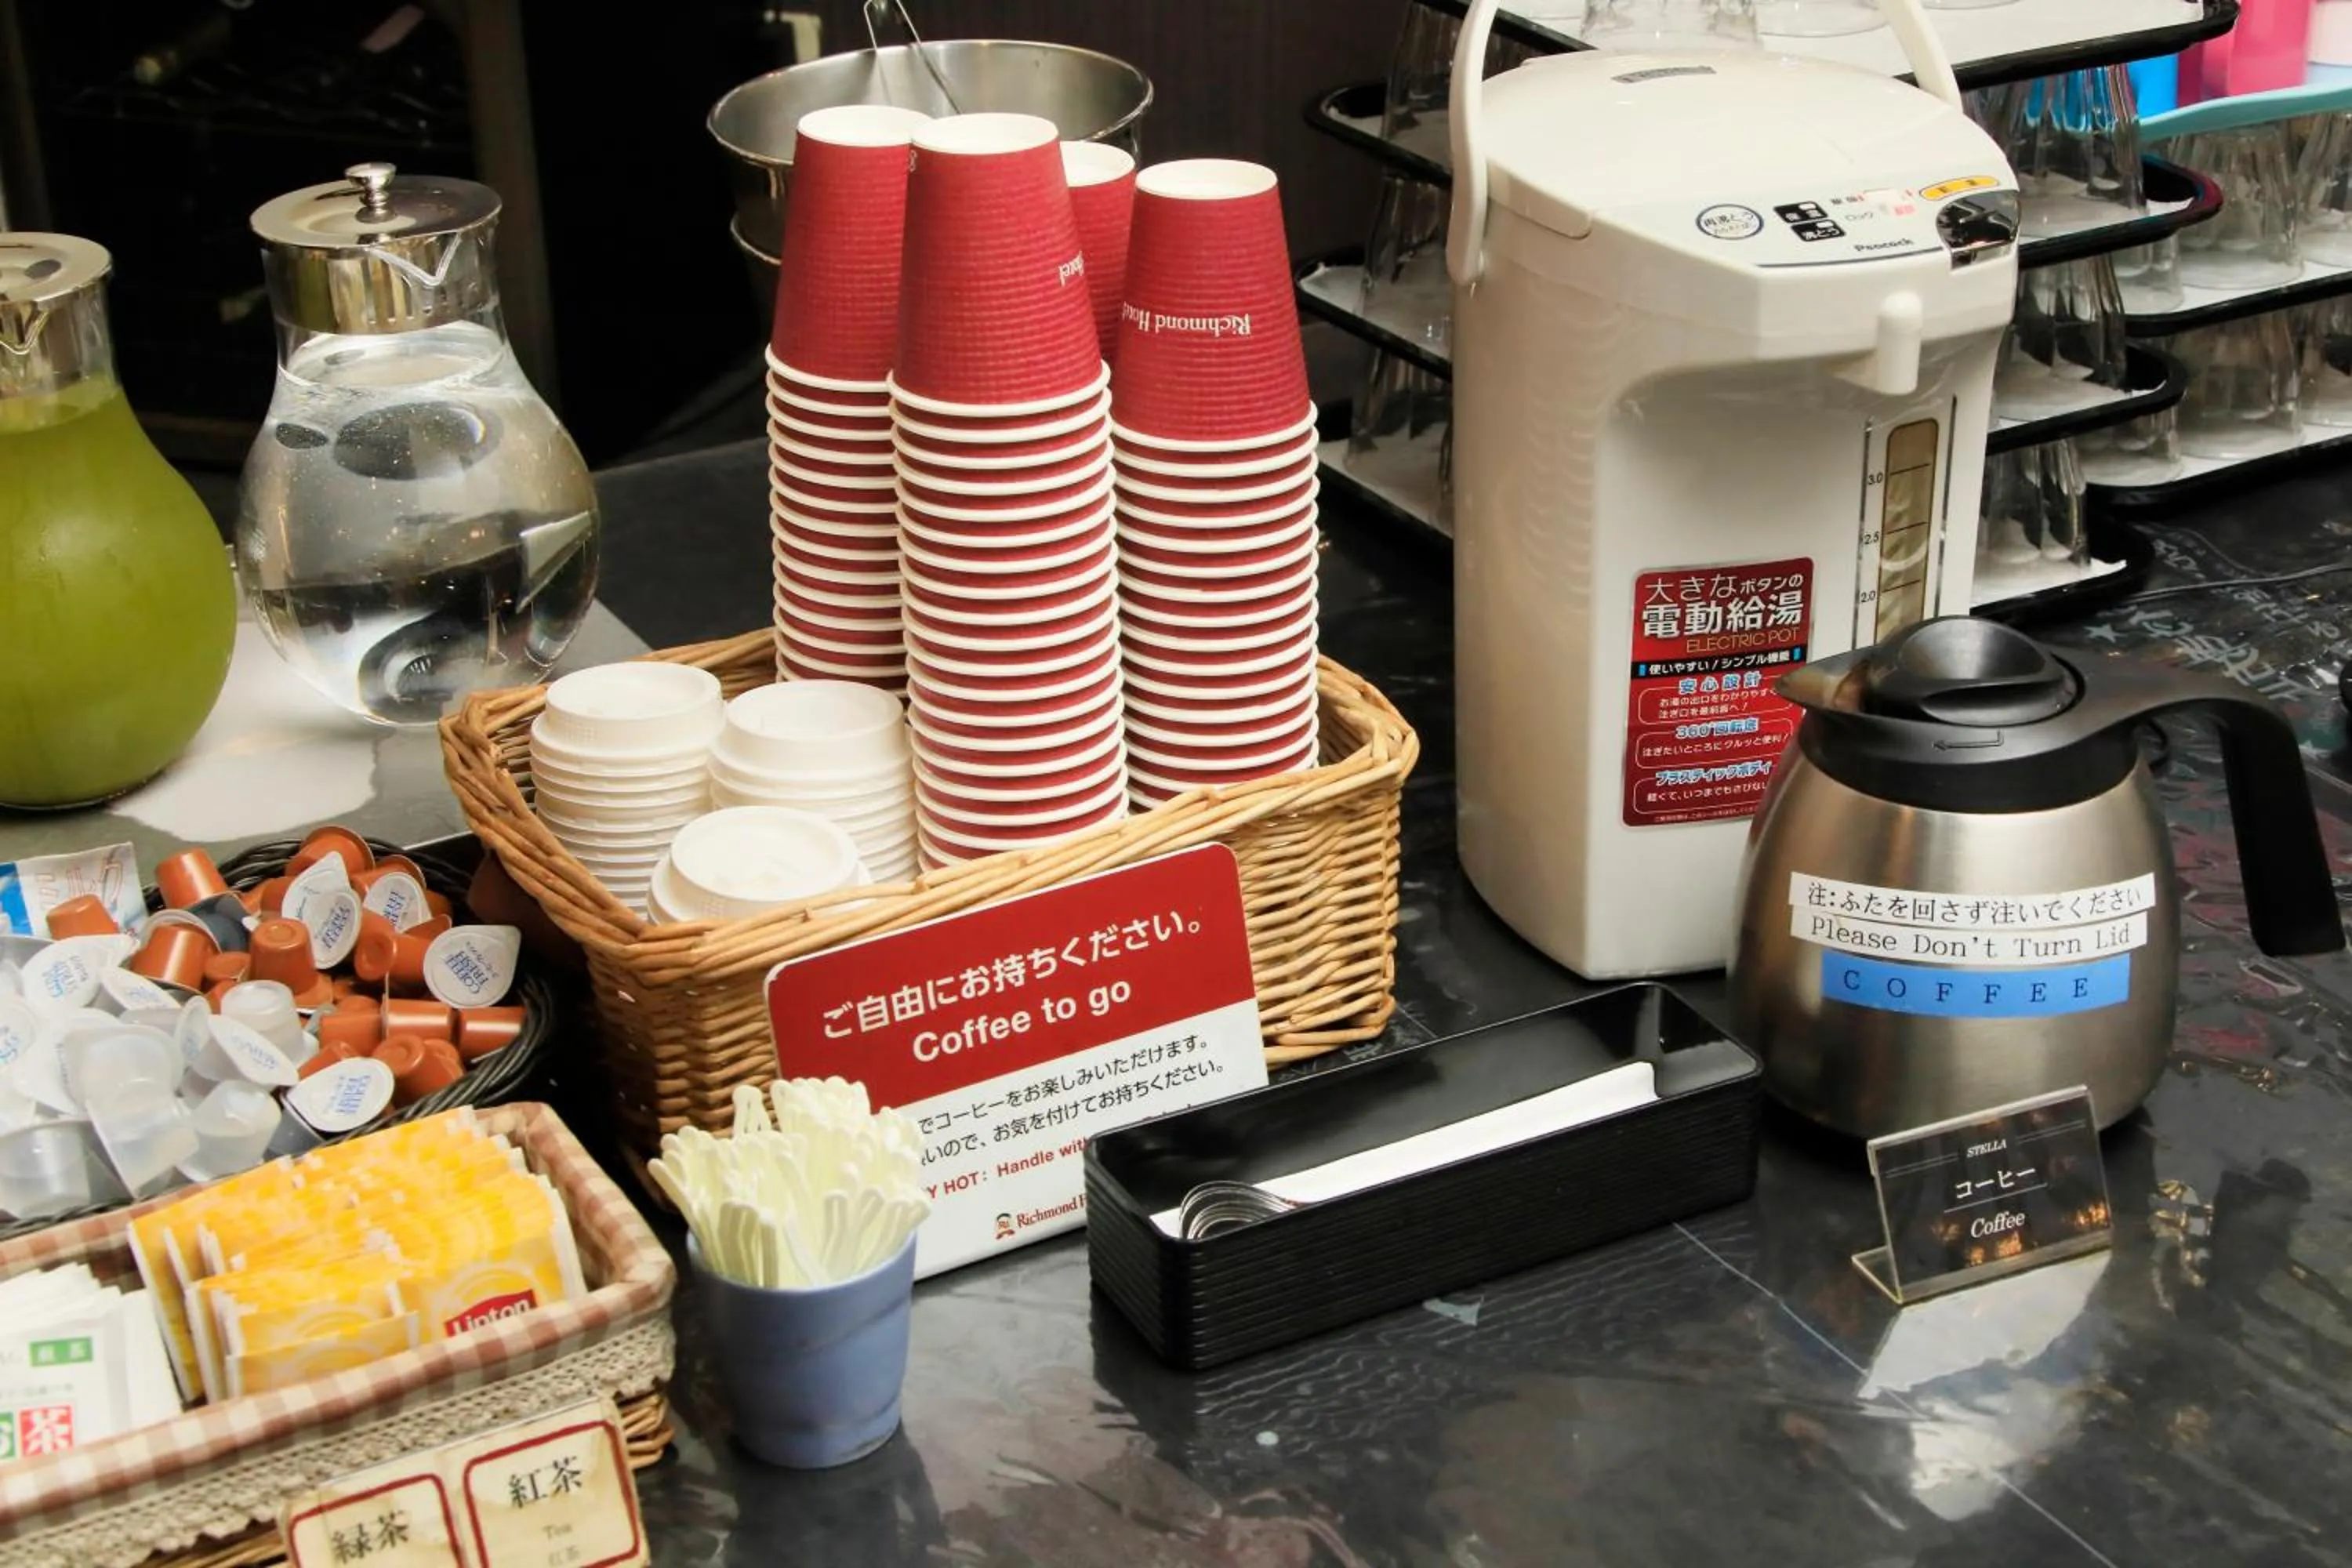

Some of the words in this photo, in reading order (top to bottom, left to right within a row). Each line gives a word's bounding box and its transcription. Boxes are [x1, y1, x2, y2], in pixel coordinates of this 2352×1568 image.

[1156, 313, 1252, 337] Richmond
[1867, 470, 1883, 485] 3.0
[1863, 531, 1880, 546] 2.5
[1644, 573, 1804, 605] 大きなボタンの
[1860, 590, 1876, 604] 2.0
[1642, 590, 1804, 639] 電動給湯
[1686, 632, 1765, 653] ELECTRIC
[1768, 627, 1800, 644] POT
[1678, 670, 1762, 695] 安心設計
[1812, 916, 1898, 951] Please
[1914, 934, 1998, 958] Don't
[2013, 935, 2082, 959] Turn
[2096, 923, 2131, 950] Lid
[823, 909, 1201, 1040] ご自由にお持ちください。
[913, 1009, 1032, 1063] Coffee
[1041, 996, 1077, 1025] to
[1088, 979, 1132, 1018] go
[921, 1059, 1225, 1166] いので、お気を付けてお持ちください。
[996, 1150, 1054, 1178] Handle
[1966, 1138, 2007, 1158] STELLA
[1956, 1167, 2036, 1199] コーヒー
[1017, 1196, 1078, 1229] Richmond
[1970, 1211, 2026, 1239] Coffee
[509, 1456, 583, 1508] 紅茶
[332, 1509, 411, 1565] 緑茶
